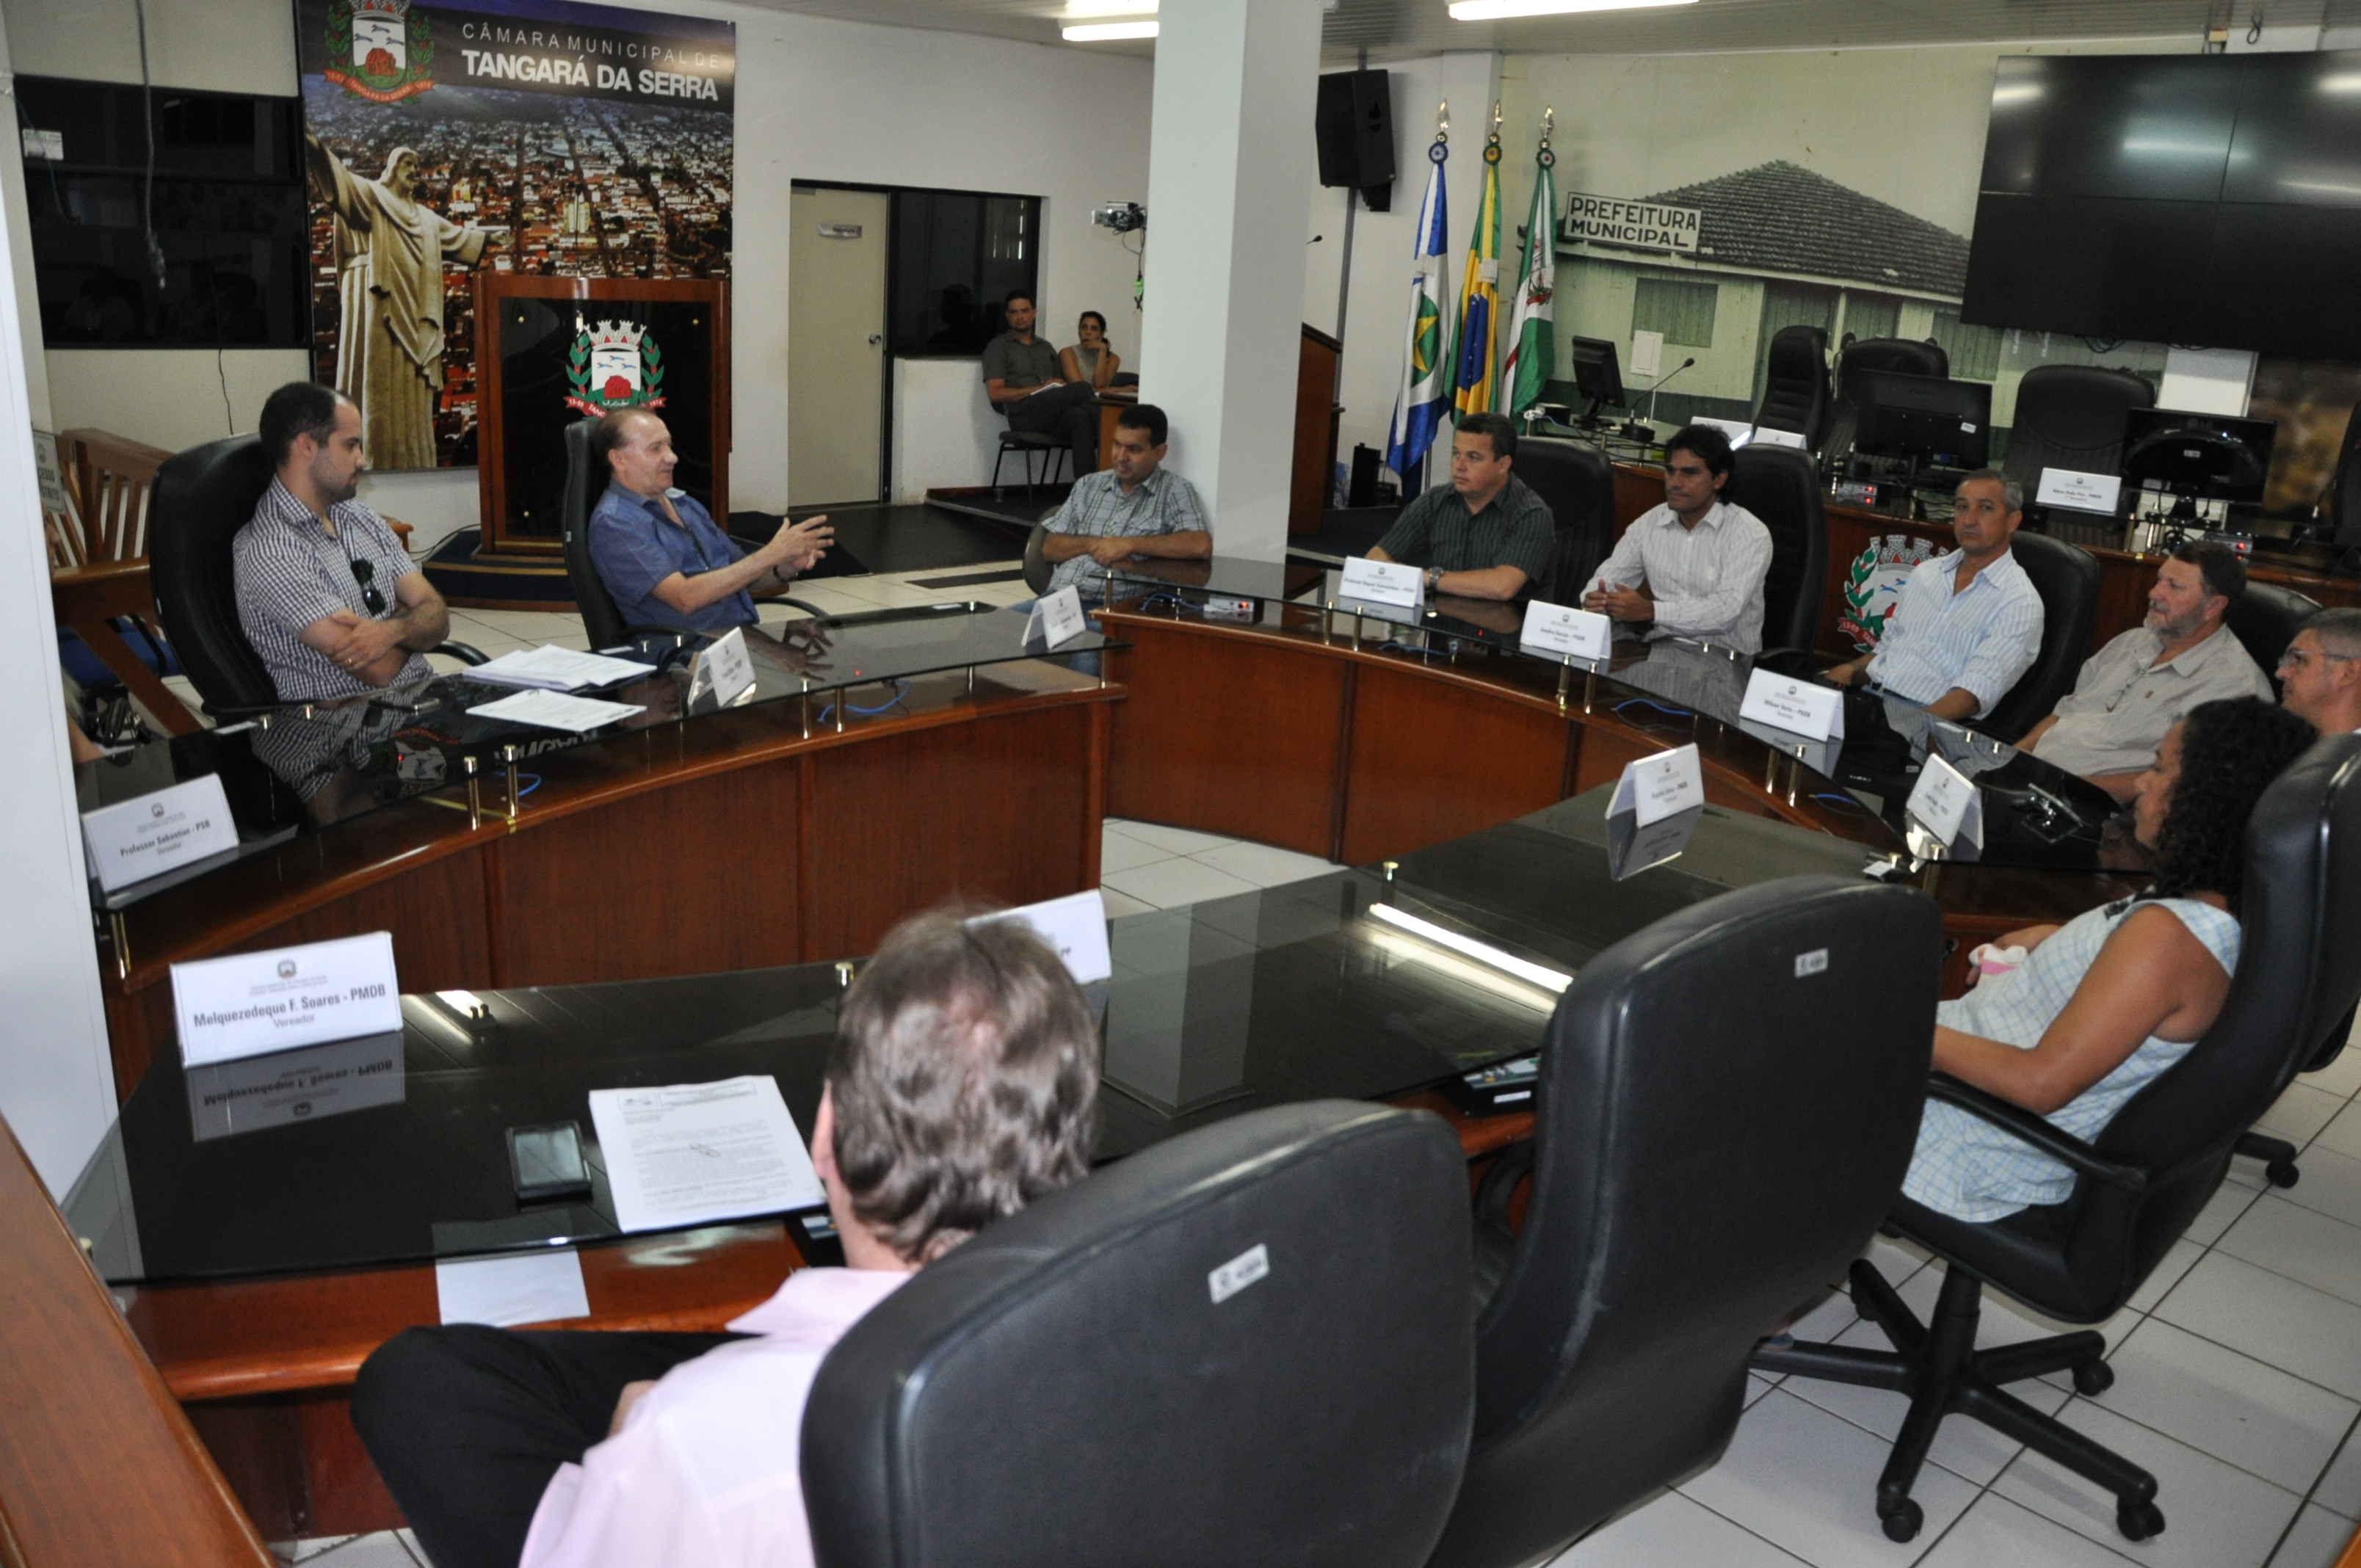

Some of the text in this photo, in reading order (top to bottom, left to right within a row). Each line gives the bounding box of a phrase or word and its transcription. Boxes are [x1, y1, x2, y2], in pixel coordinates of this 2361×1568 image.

[462, 21, 719, 68] CÂMARA MUNICIPAL DE
[462, 50, 719, 101] TANGARÁ DA SERRA
[1570, 197, 1697, 231] PREFEITURA
[1570, 218, 1689, 247] MUNICIPAL
[120, 840, 156, 857] Professor
[156, 827, 191, 846] Sebastian
[195, 819, 211, 832] PSB
[194, 1003, 286, 1028] Melquezedeque
[289, 998, 298, 1012] F.
[301, 991, 341, 1011] Soares
[350, 983, 386, 1003] PMDB
[273, 1015, 316, 1029] Vereador
